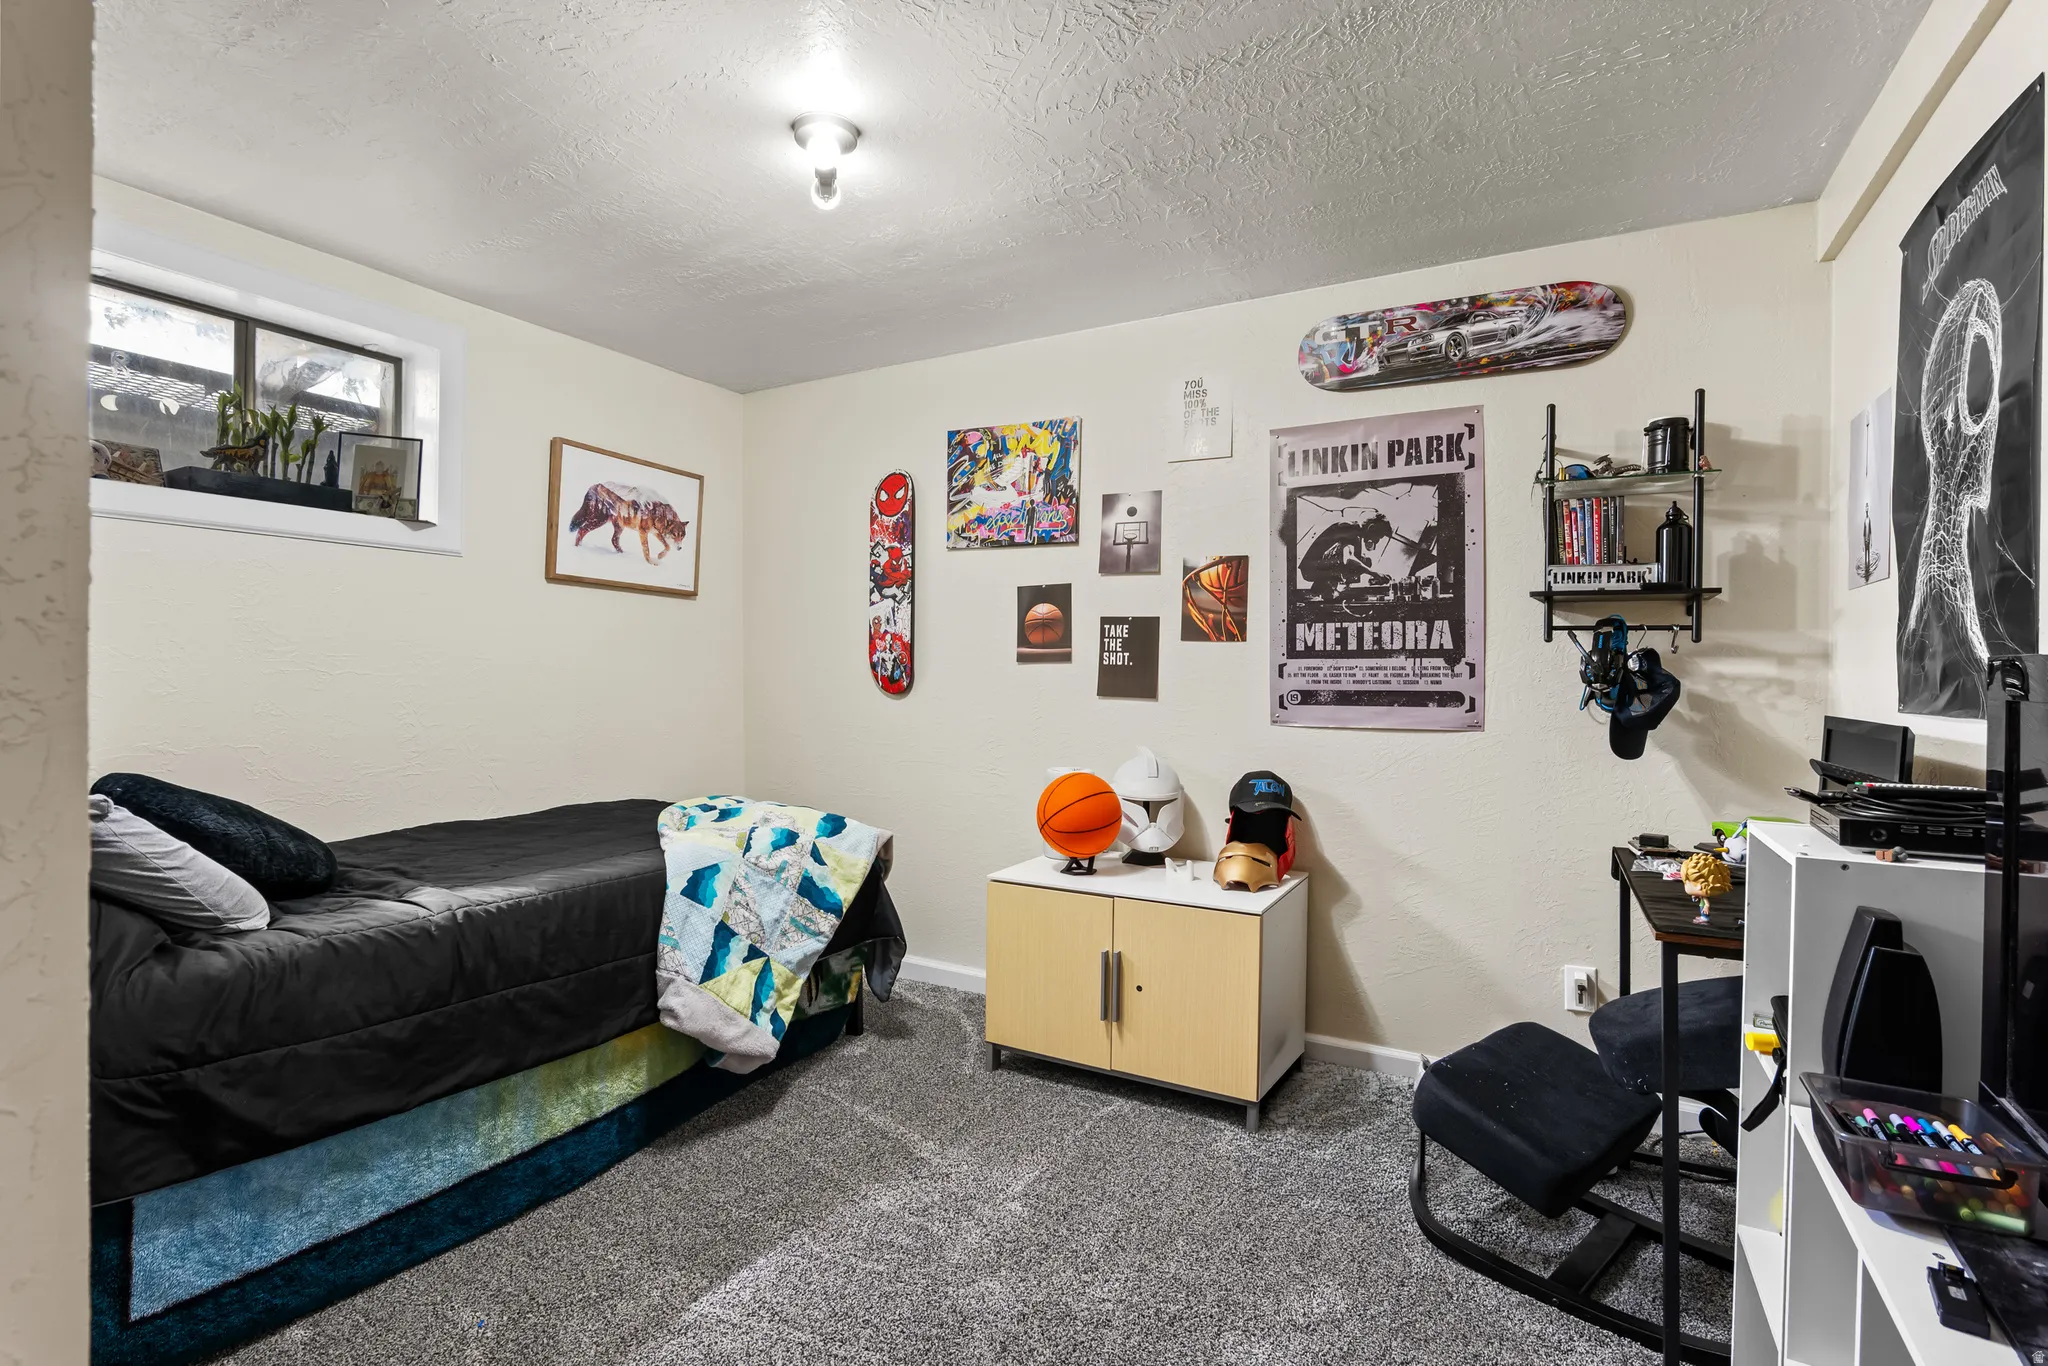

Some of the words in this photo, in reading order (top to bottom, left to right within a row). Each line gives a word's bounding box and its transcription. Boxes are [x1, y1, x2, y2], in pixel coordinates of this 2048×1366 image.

[1922, 164, 2008, 305] SPIDER-MAN
[1184, 379, 1203, 390] YOU
[1183, 388, 1208, 400] MISS
[1184, 399, 1207, 409] 100%
[1184, 409, 1197, 419] OF
[1201, 406, 1219, 417] THE
[1287, 441, 1379, 478] LINKIN
[1387, 432, 1466, 468] PARK
[1553, 571, 1602, 584] LINKIN
[1607, 570, 1648, 584] PARK
[1104, 625, 1129, 637] TAKE
[1295, 619, 1454, 651] METEORA
[1103, 638, 1122, 651] THE
[1103, 652, 1133, 665] SHOT.
[1249, 779, 1285, 797] TALON
